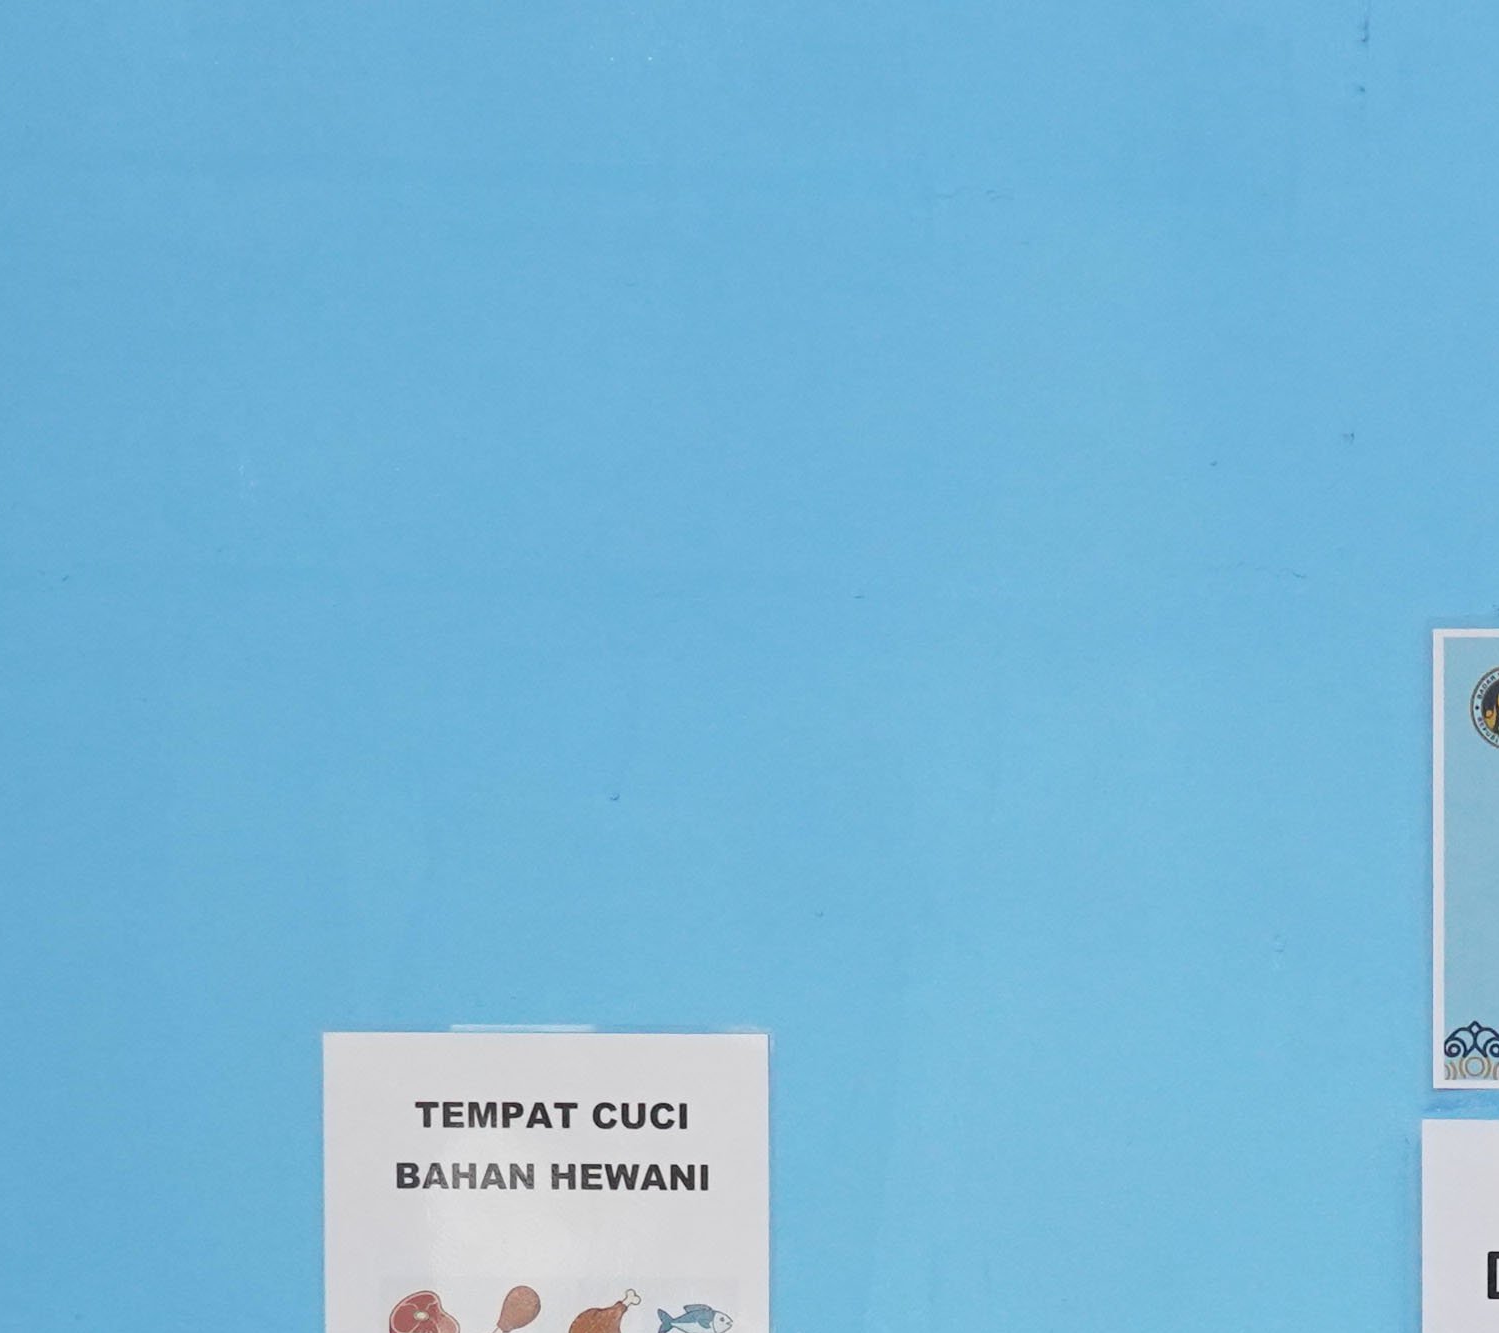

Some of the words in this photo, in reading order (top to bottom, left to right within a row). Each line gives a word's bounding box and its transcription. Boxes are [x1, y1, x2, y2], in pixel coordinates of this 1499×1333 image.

[414, 1101, 578, 1129] TEMPAT
[592, 1101, 688, 1130] CUCI
[396, 1162, 535, 1190] BAHAN
[551, 1163, 709, 1191] HEWANI
